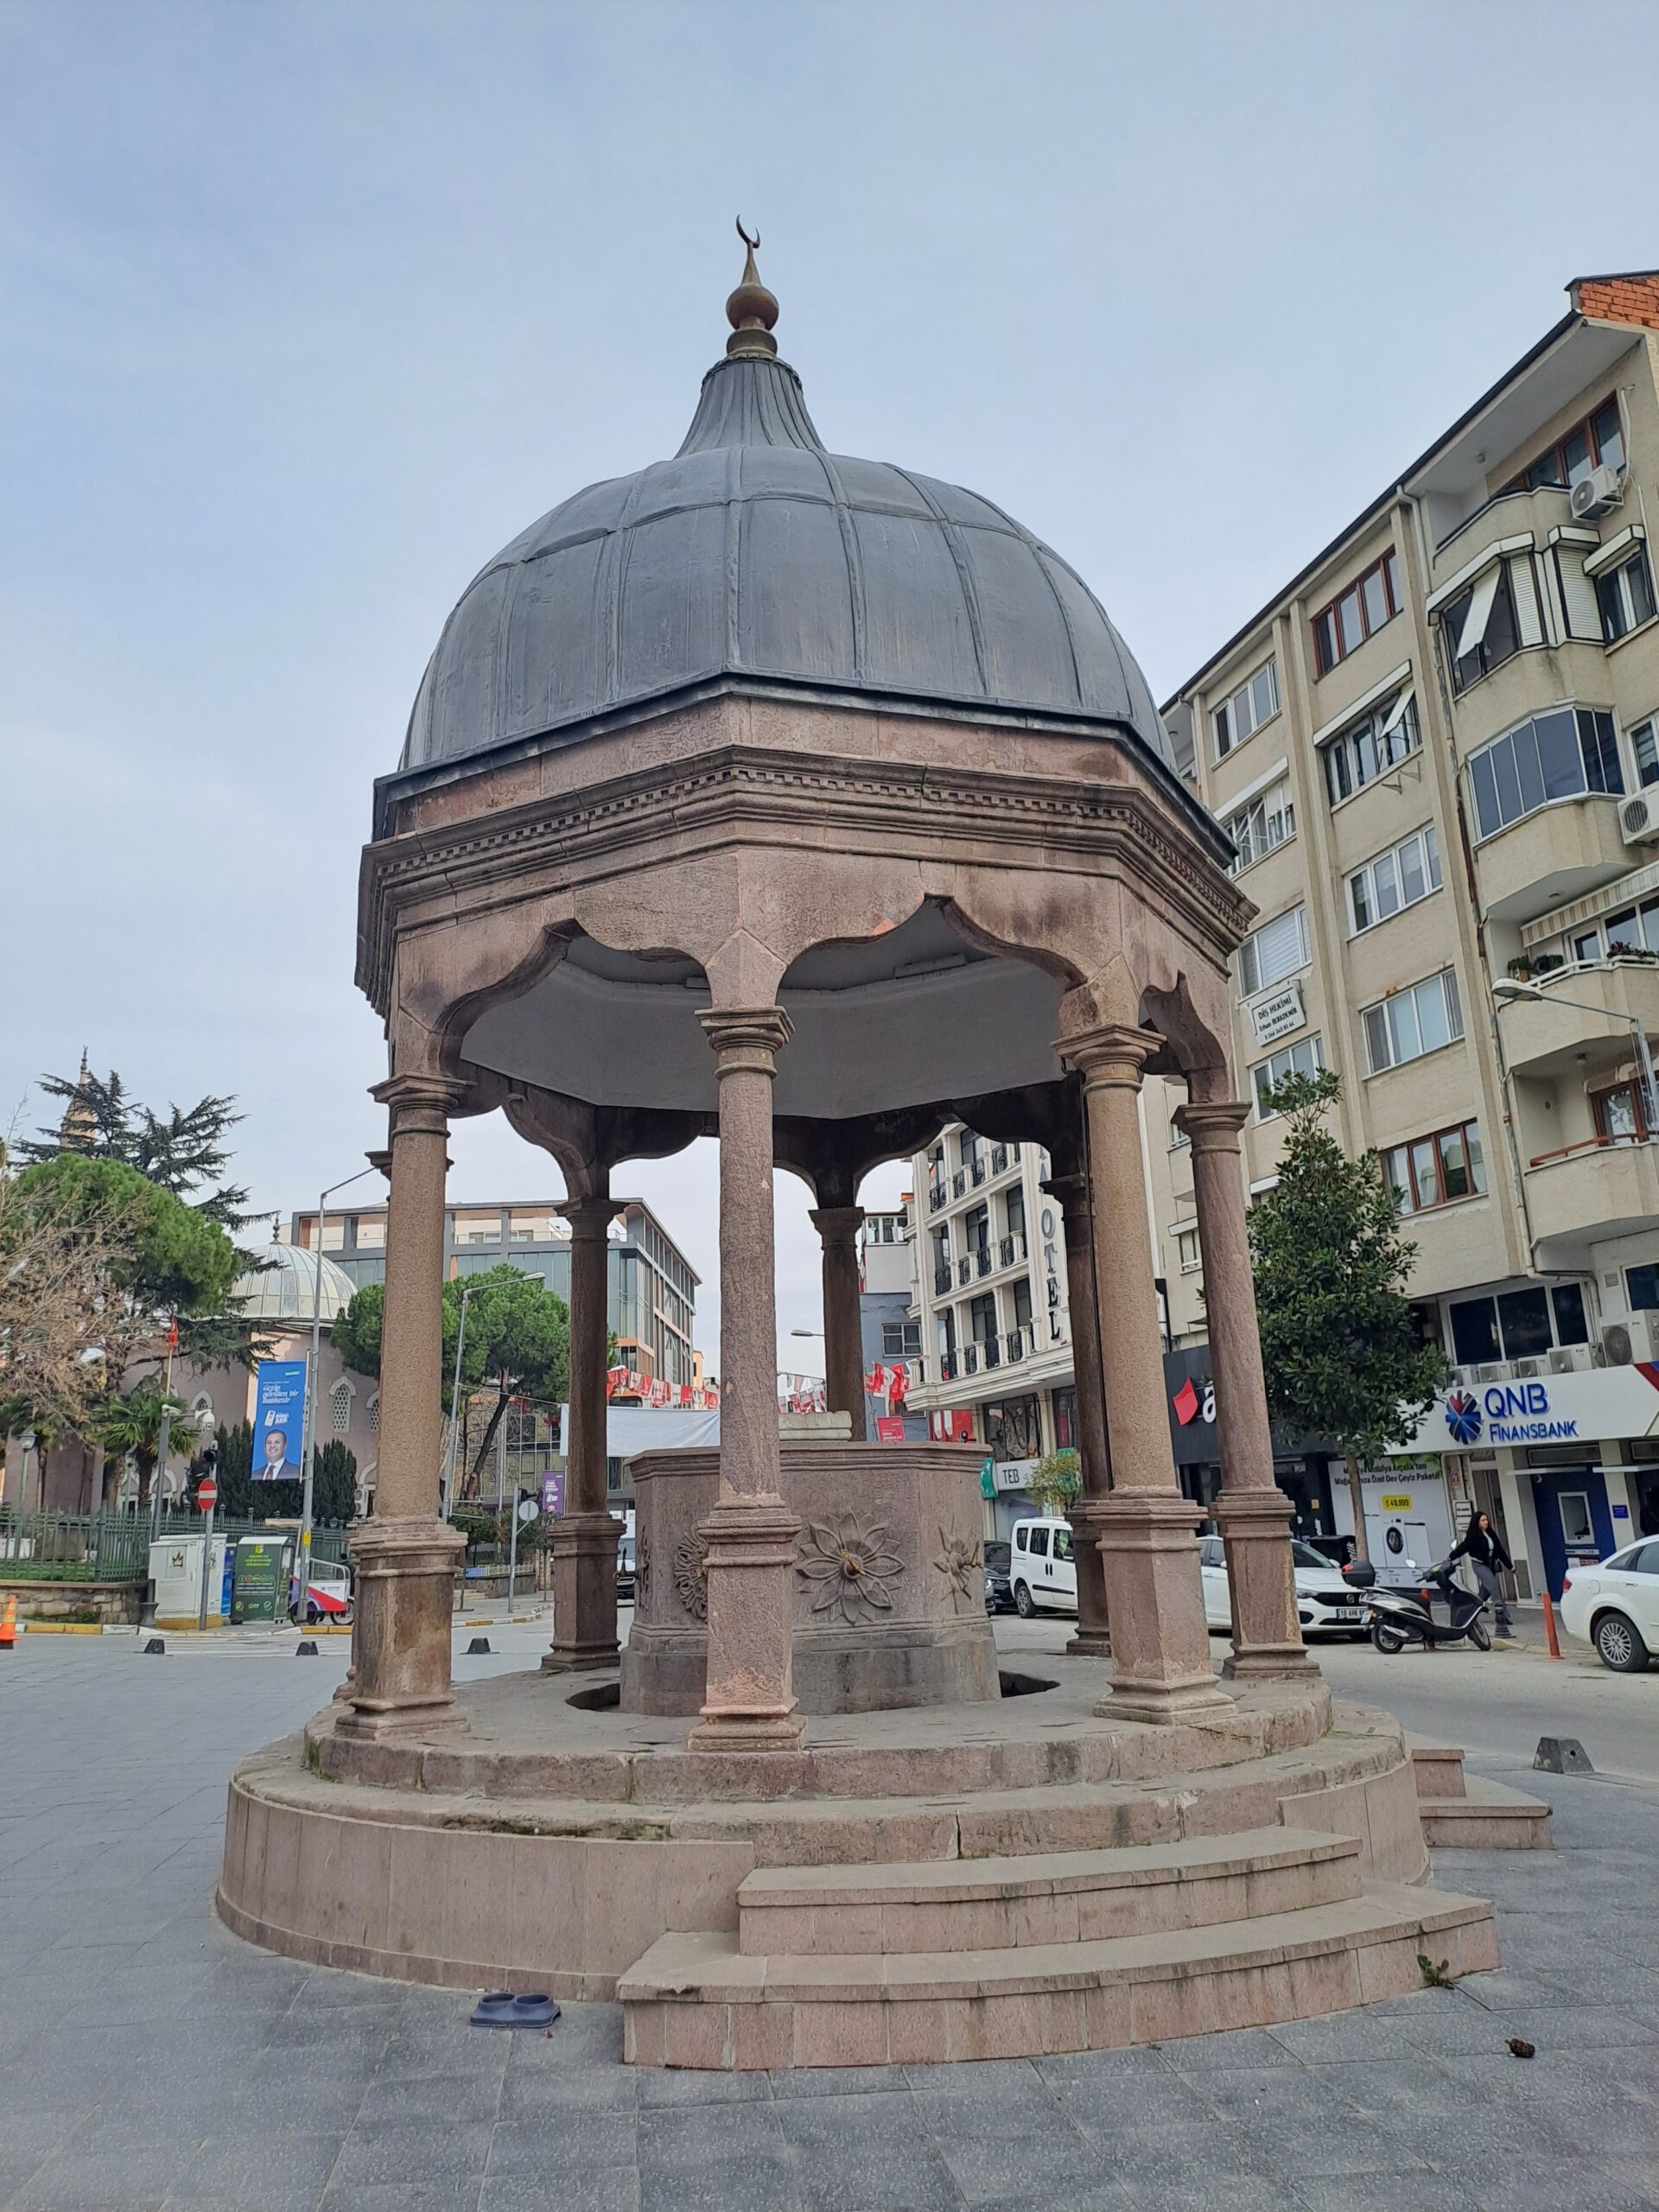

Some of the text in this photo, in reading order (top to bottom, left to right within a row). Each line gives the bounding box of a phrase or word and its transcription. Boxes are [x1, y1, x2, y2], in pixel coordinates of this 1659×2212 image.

[1269, 994, 1292, 1014] HEKİMİ
[1041, 1208, 1061, 1340] OTEL
[1484, 1383, 1548, 1419] QNB
[1490, 1420, 1580, 1443] FINANSBANK
[1002, 1469, 1020, 1484] TEB
[1371, 1474, 1385, 1484] Özel
[1385, 1474, 1397, 1483] Dev
[1398, 1473, 1415, 1484] Çeyiz
